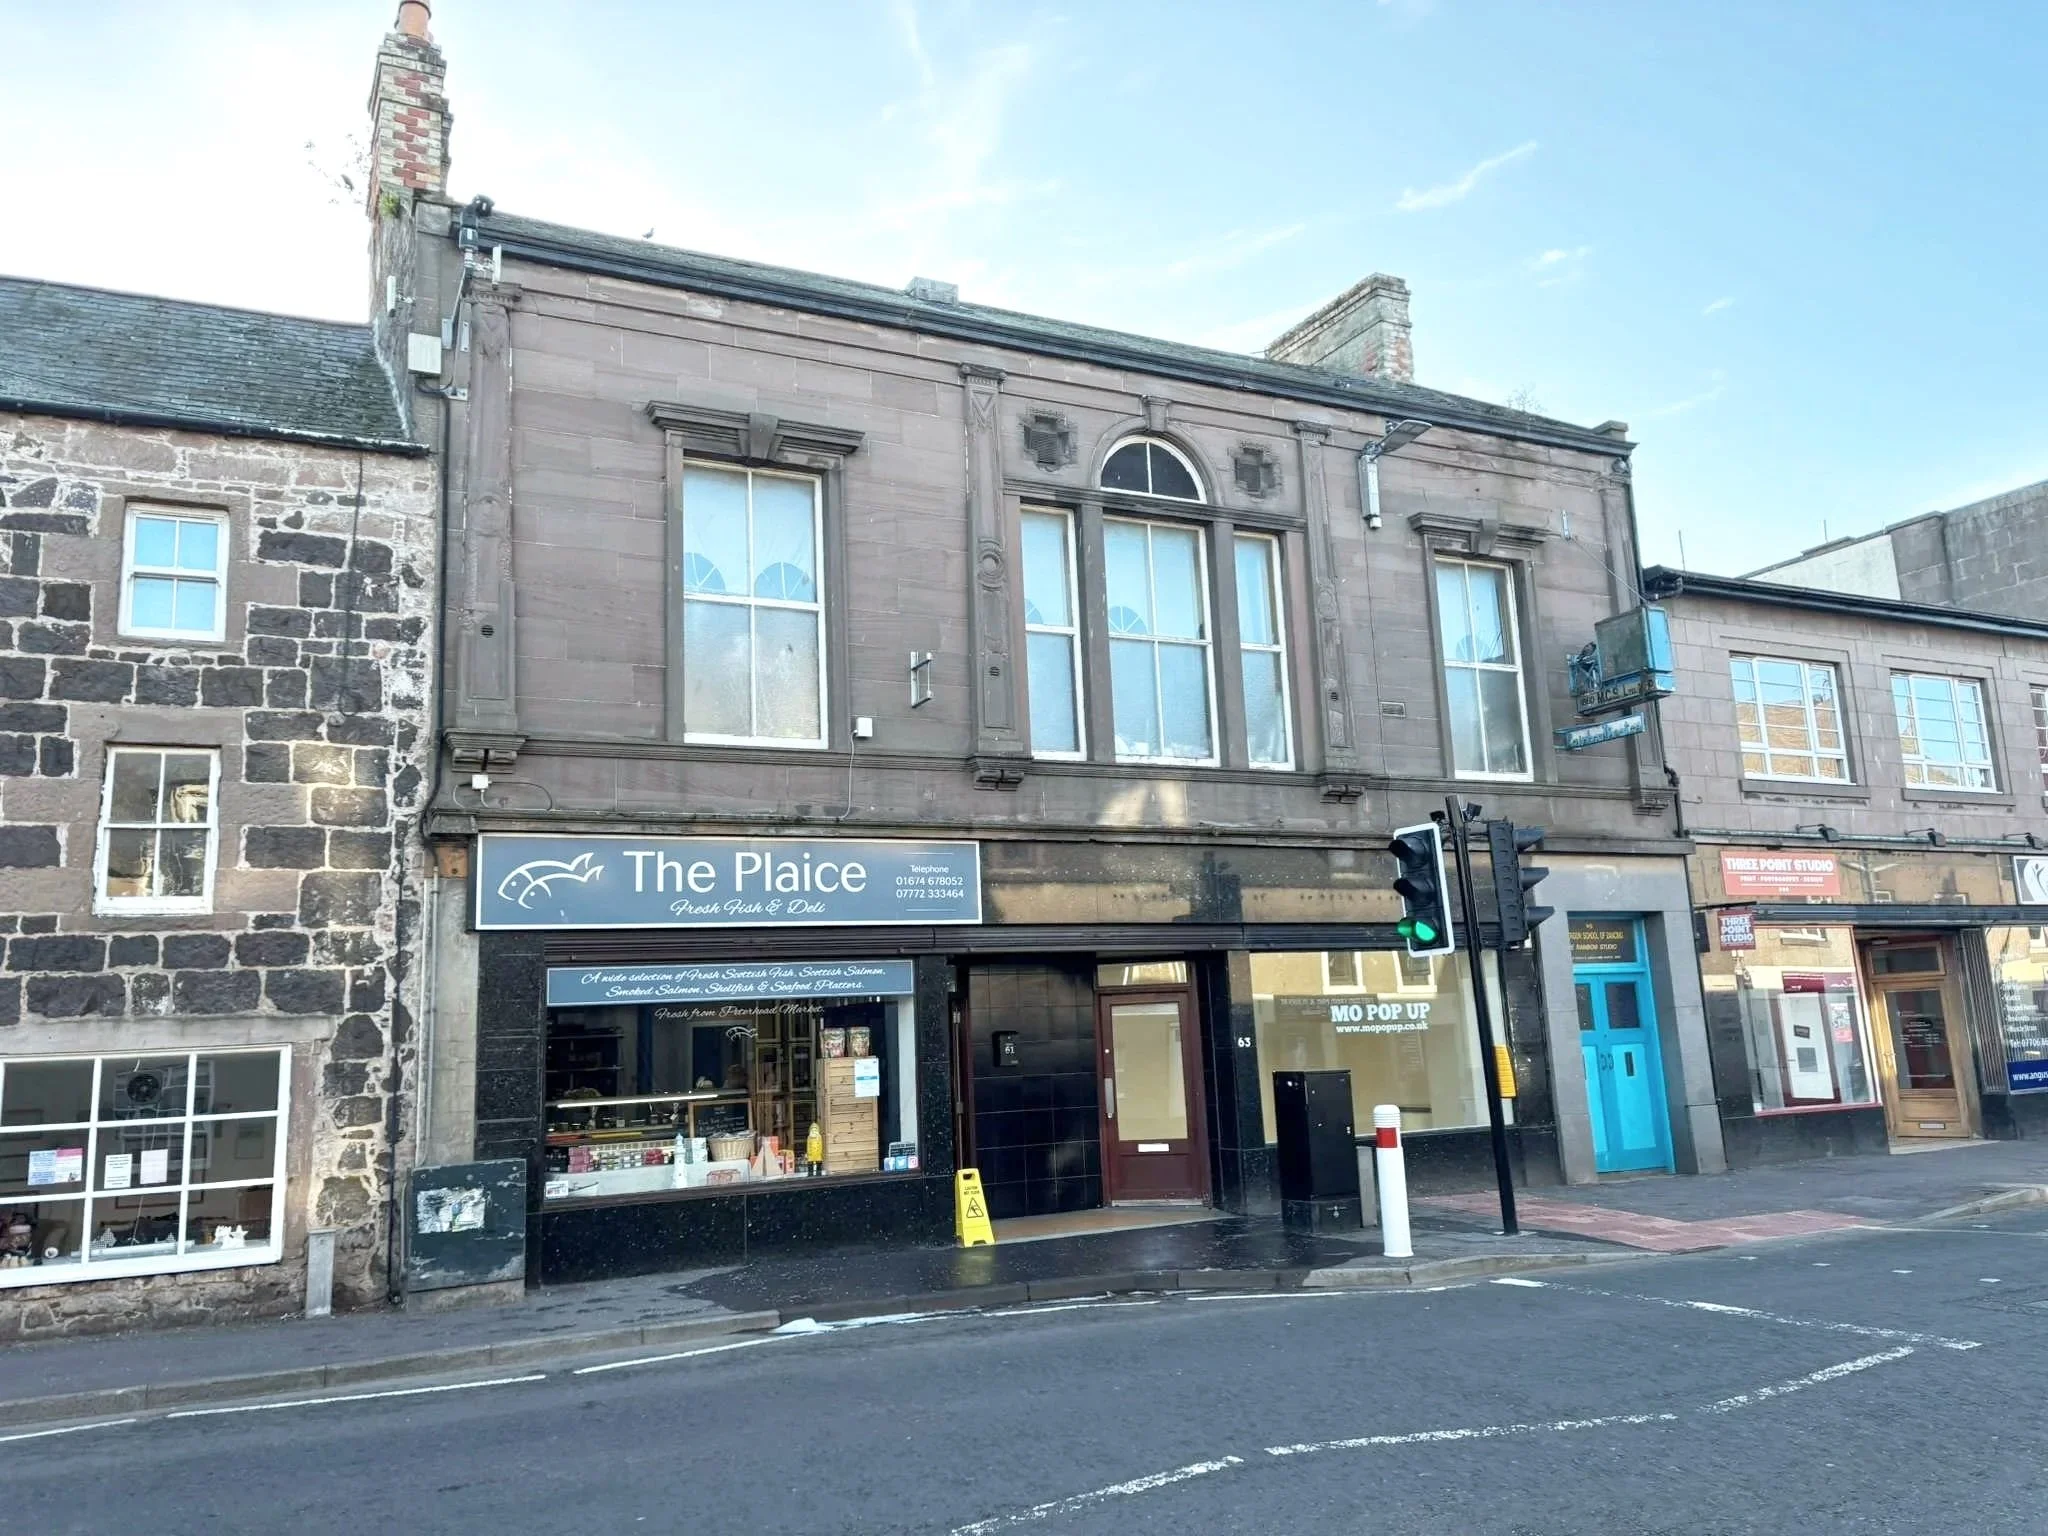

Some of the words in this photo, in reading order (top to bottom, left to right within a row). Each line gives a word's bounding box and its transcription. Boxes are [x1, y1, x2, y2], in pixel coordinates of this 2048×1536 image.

[910, 865, 949, 874] Telephone
[1724, 858, 1759, 871] THREE
[1760, 859, 1793, 871] POINT
[1794, 859, 1834, 872] STUDIO
[623, 850, 716, 893] The
[735, 851, 867, 893] Plaice
[896, 876, 926, 886] 01674
[928, 876, 963, 886] 678052
[896, 889, 926, 899] 07772
[928, 889, 964, 899] 333464
[670, 899, 721, 916] Fresh
[723, 898, 763, 915] Fish
[765, 898, 783, 916] &
[787, 899, 826, 914] Deli
[1721, 915, 1750, 926] THREE
[1721, 925, 1752, 935] POINT
[1721, 933, 1754, 944] STUDIO
[581, 972, 601, 985] A
[601, 973, 627, 982] wide
[628, 972, 673, 982] selection
[675, 970, 687, 982] of
[686, 968, 720, 981] Fresh
[721, 968, 767, 980] Scottish
[800, 966, 841, 978] Scottish
[605, 985, 653, 998] Smoked
[704, 982, 754, 995] Shellfish
[756, 981, 769, 994] &
[770, 980, 812, 993] Seafood
[654, 1007, 689, 1020] Fresh
[687, 1007, 716, 1021] from
[718, 1005, 778, 1017] Peterhead
[1330, 1004, 1363, 1022] MO
[1366, 1003, 1402, 1021] POP
[1406, 1002, 1430, 1019] UP
[1238, 1036, 1251, 1048] 63
[1005, 1045, 1015, 1055] 61
